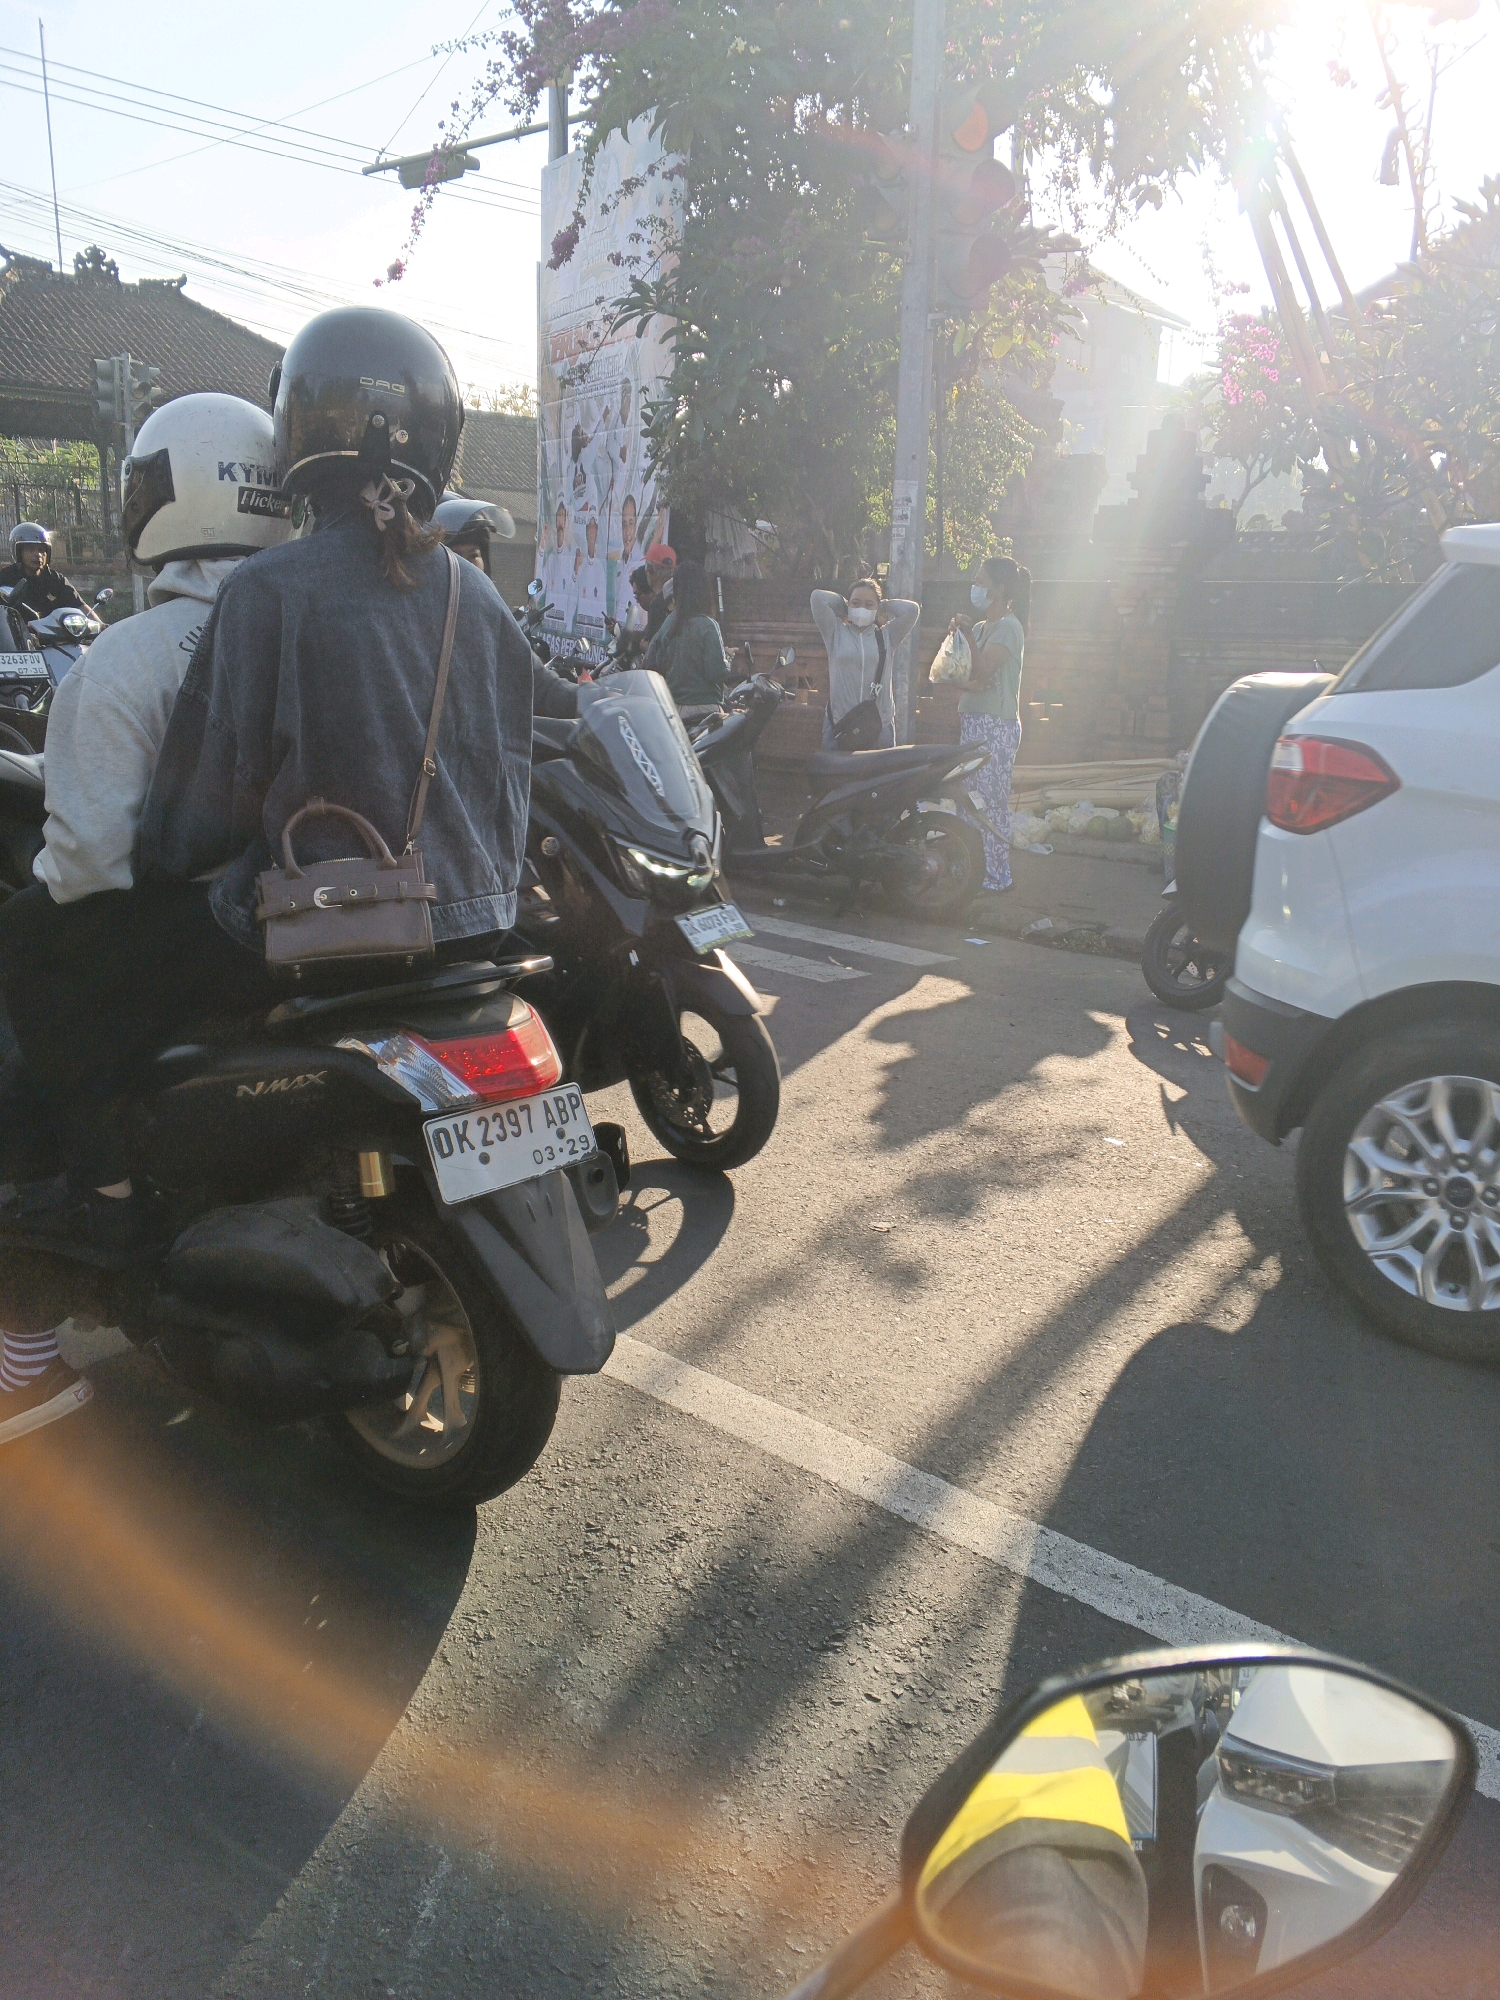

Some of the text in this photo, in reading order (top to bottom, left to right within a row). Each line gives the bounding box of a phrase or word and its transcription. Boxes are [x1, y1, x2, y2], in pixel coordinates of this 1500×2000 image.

[359, 376, 406, 394] DAG
[235, 1070, 328, 1098] NMAX
[432, 1092, 581, 1160] DK 2397 ABP
